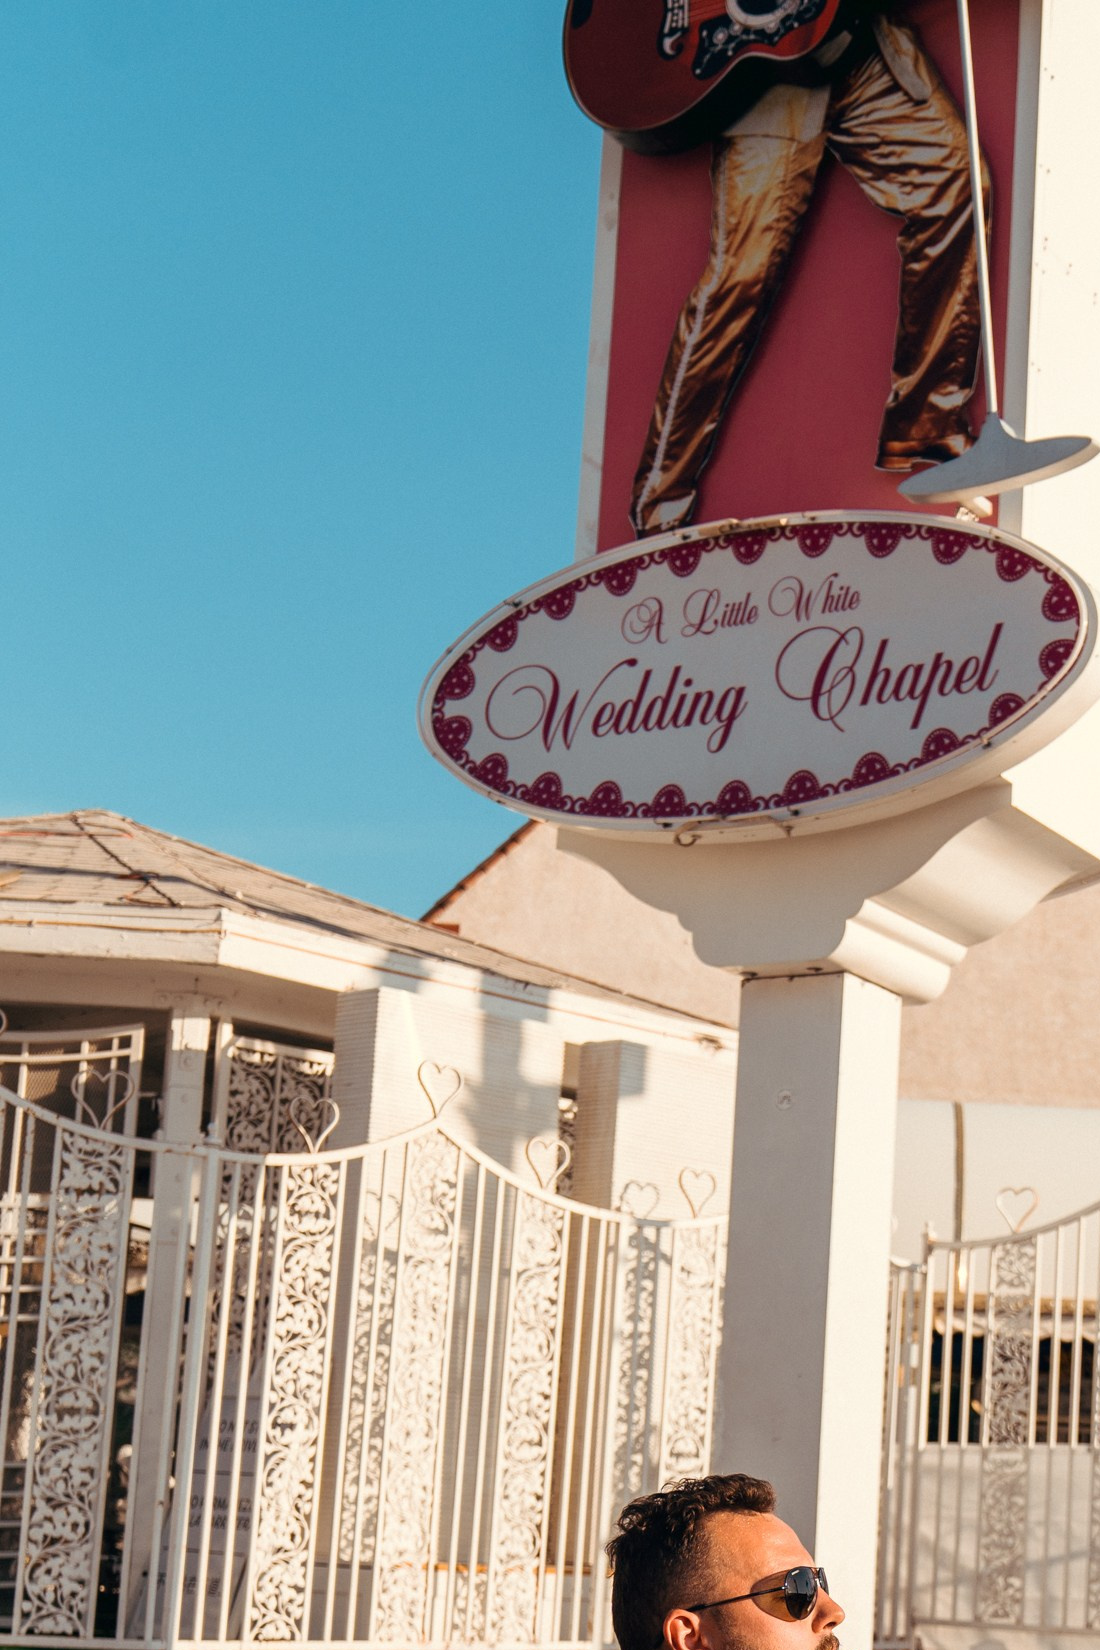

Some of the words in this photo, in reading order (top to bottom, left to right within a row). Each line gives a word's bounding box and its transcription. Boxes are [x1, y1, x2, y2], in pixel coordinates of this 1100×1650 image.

[621, 596, 668, 645] A
[679, 589, 758, 639] Little
[767, 571, 861, 624] White
[485, 658, 748, 754] Wedding
[775, 622, 1004, 733] Chapel
